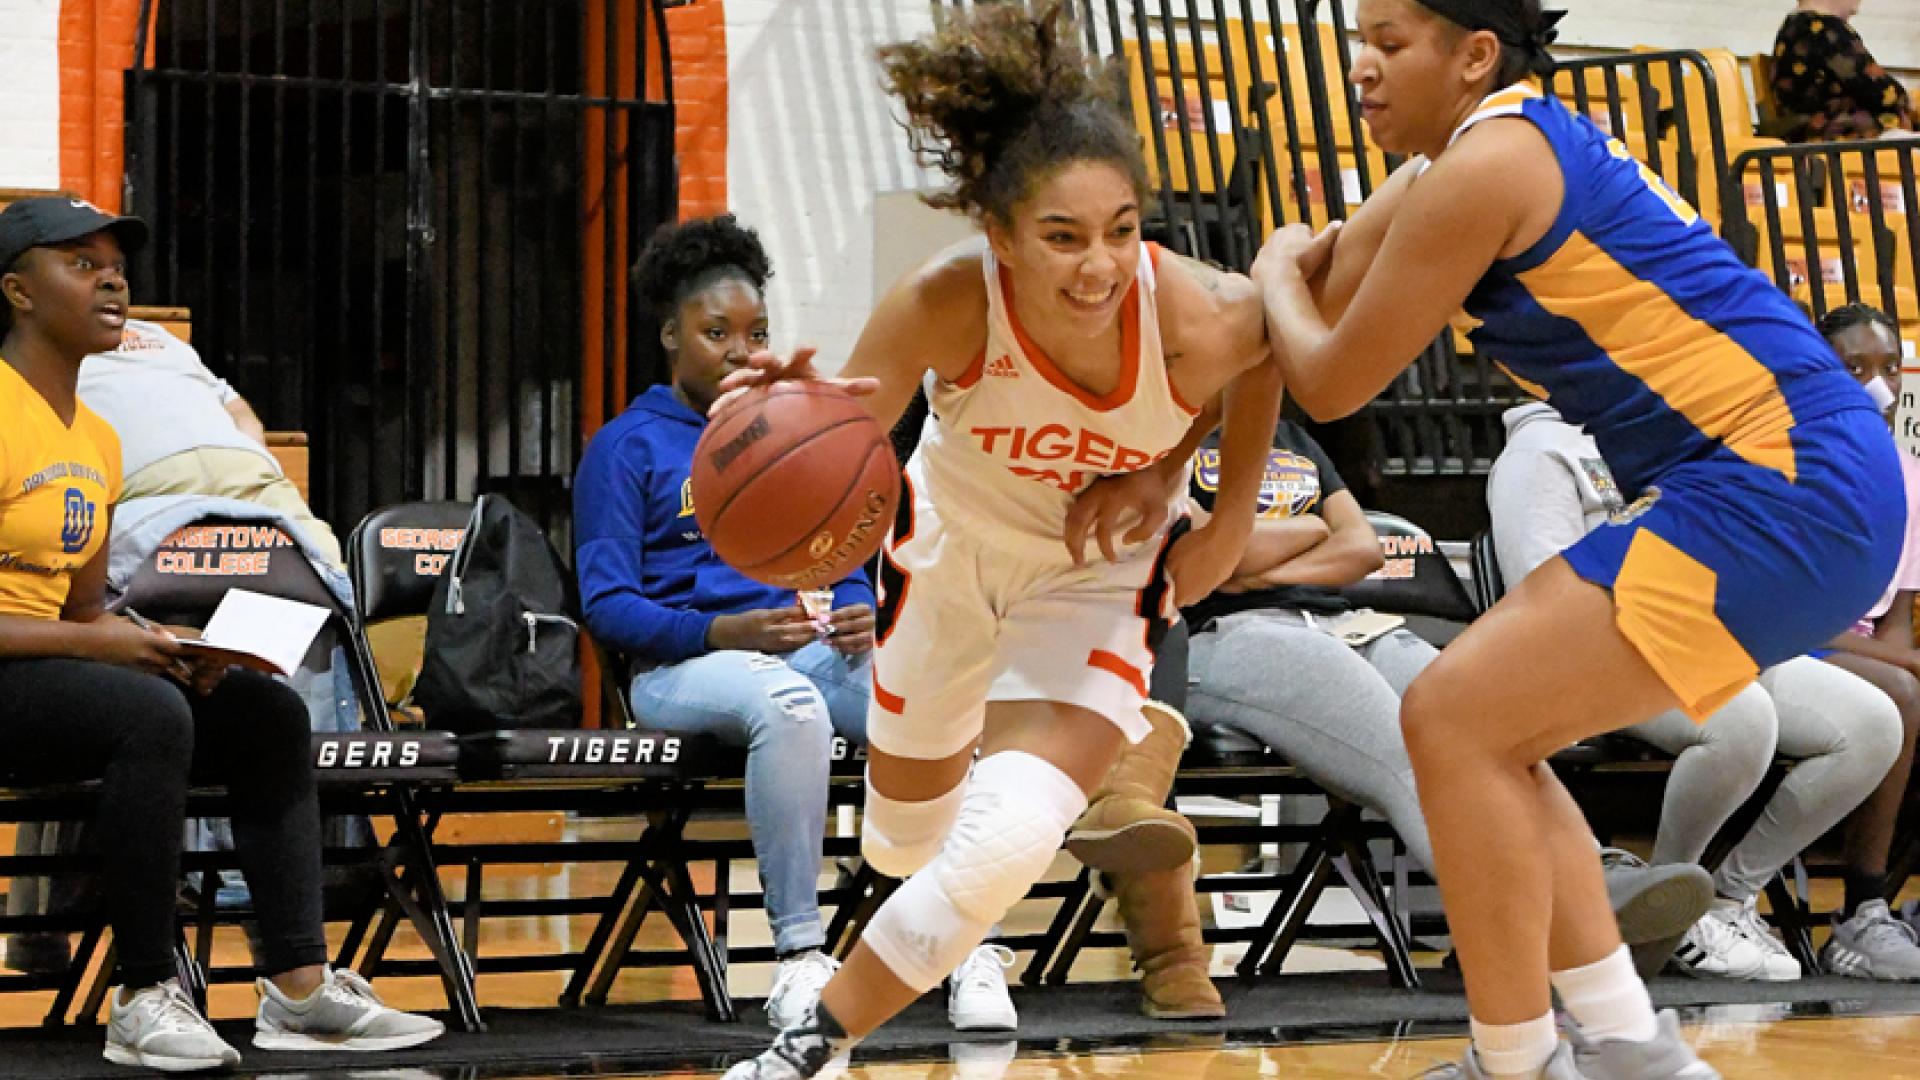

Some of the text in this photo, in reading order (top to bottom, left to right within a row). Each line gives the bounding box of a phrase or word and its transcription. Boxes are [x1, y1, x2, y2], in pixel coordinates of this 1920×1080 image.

[157, 551, 271, 575] COLLEGE
[415, 553, 450, 575] CO
[317, 741, 421, 767] GERS
[548, 737, 682, 763] TIGERS
